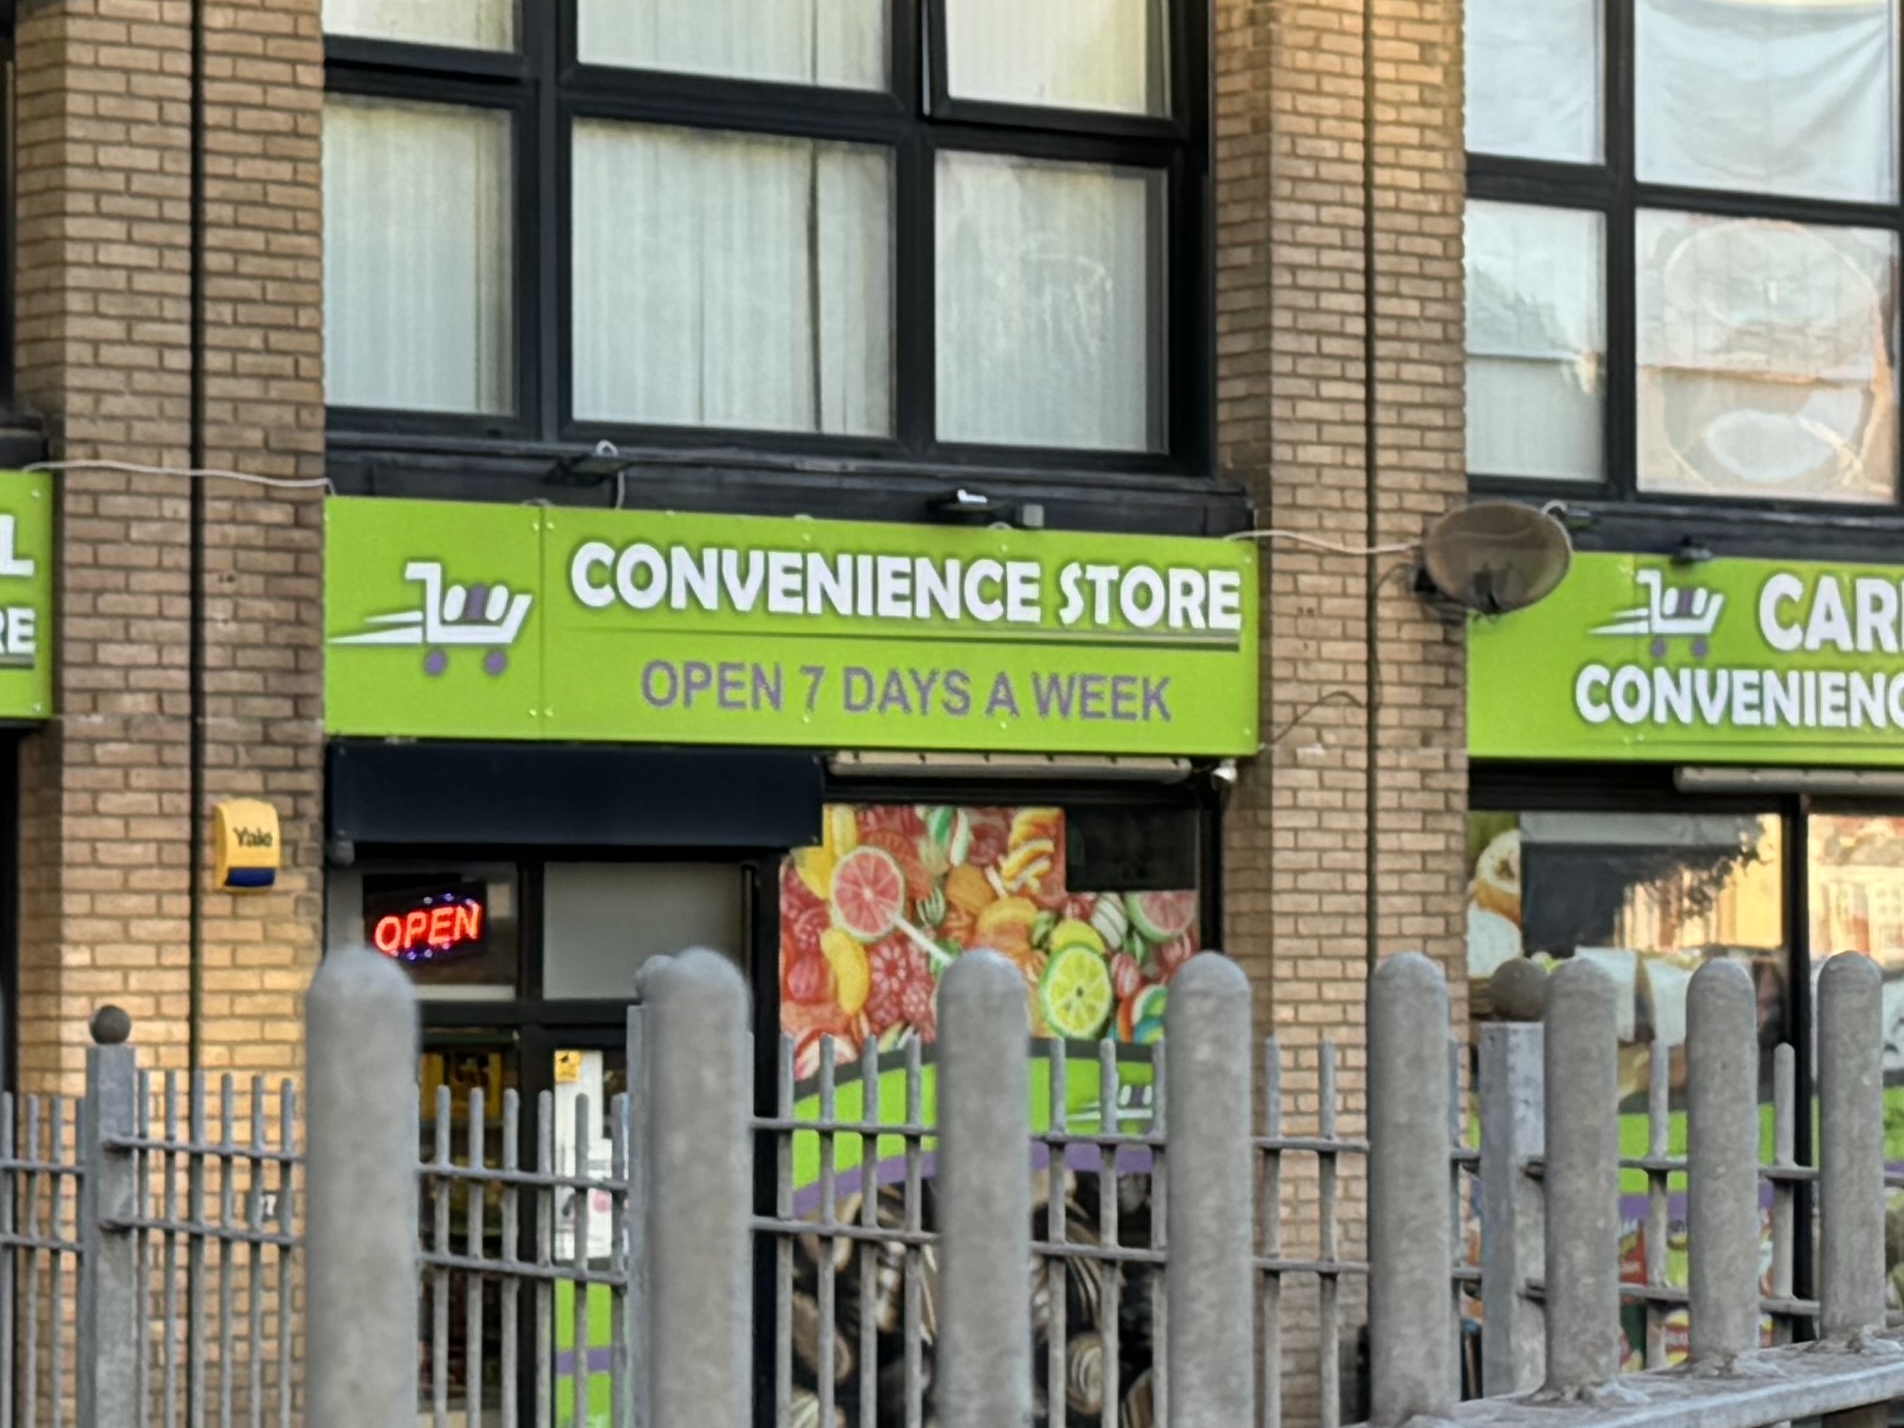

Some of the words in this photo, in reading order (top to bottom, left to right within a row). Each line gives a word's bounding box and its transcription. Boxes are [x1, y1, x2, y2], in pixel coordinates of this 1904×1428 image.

[570, 541, 1042, 623] CONVENIENCE
[1059, 562, 1242, 631] STORE
[640, 659, 783, 711] OPEN
[798, 664, 827, 713] 7
[842, 666, 973, 718] DAYS
[985, 671, 1019, 719] A
[1029, 673, 1174, 722] WEEK
[232, 826, 273, 848] Yale
[375, 902, 481, 952] OPEN
